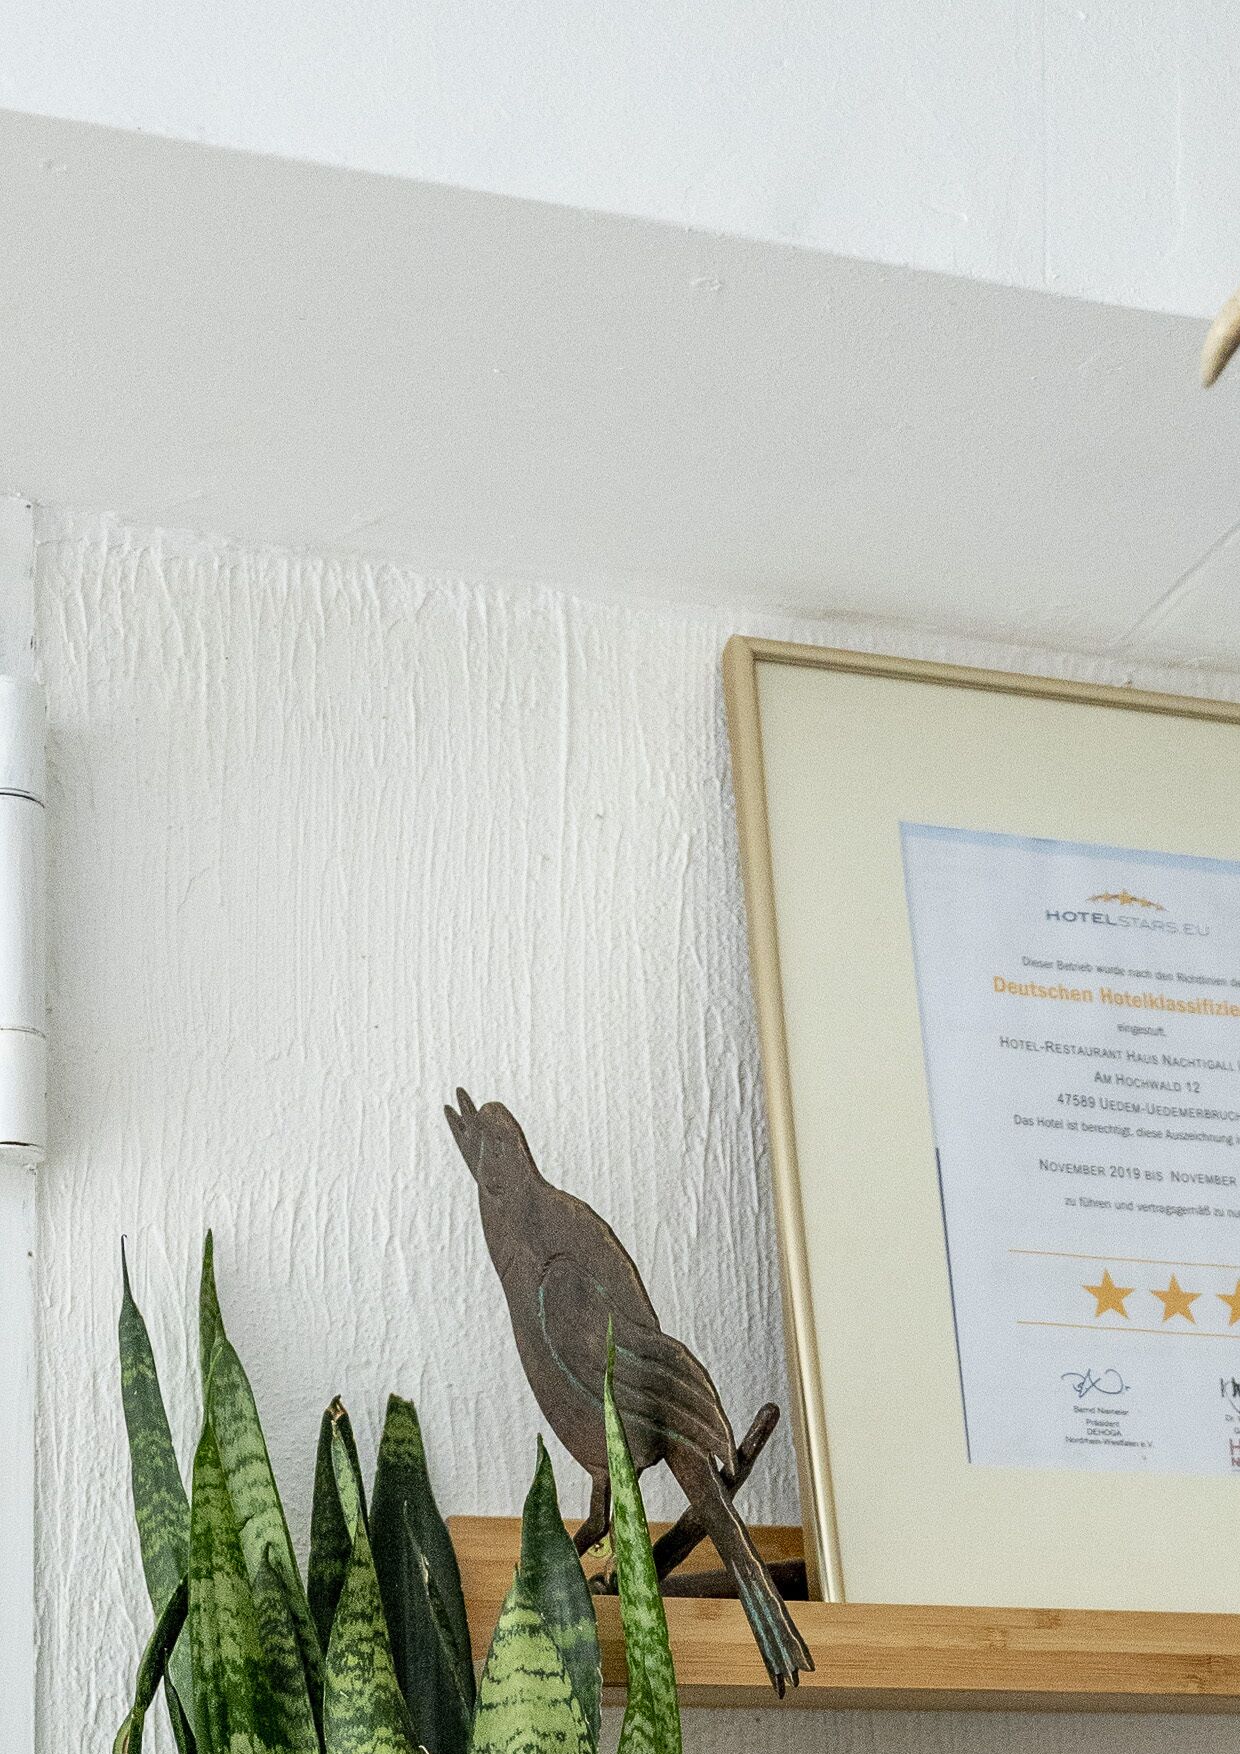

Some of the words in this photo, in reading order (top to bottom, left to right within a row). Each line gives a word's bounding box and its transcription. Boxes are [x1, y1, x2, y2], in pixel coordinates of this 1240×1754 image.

[1045, 908, 1211, 937] HOTELSTARS.EU
[993, 976, 1094, 1002] Deutschen
[1109, 1165, 1141, 1180] 2019
